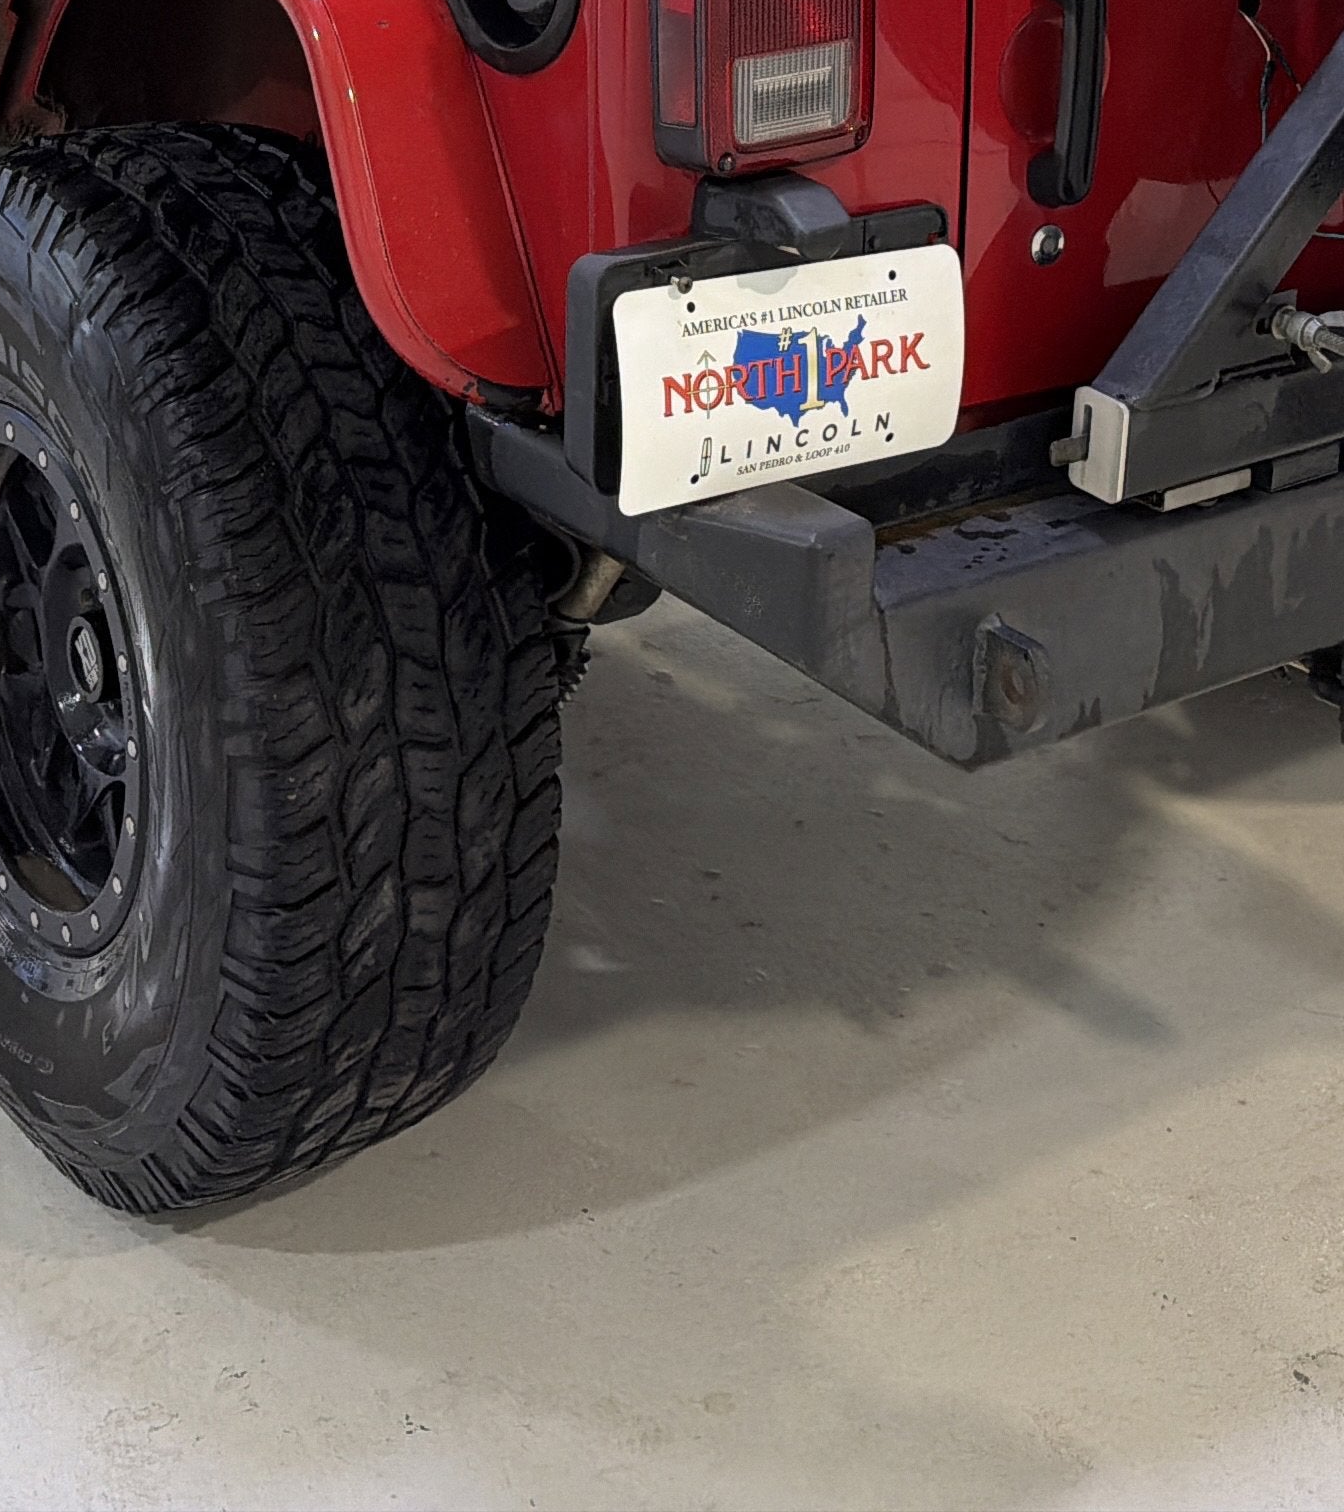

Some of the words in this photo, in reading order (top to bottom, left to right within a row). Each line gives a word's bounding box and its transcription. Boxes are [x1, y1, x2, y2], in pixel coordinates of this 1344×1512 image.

[681, 312, 757, 338] AMERICA'S
[760, 309, 774, 324] #1
[778, 298, 842, 322] LINCOLN
[845, 288, 908, 311] RETAILER
[662, 354, 802, 418] NORTH
[824, 332, 931, 387] PARK
[720, 412, 891, 465] LINCOLN
[736, 462, 757, 476] SAN
[759, 455, 792, 471] PEDRO
[794, 454, 804, 463] &
[806, 446, 833, 461] LOOP
[834, 443, 851, 454] 410
